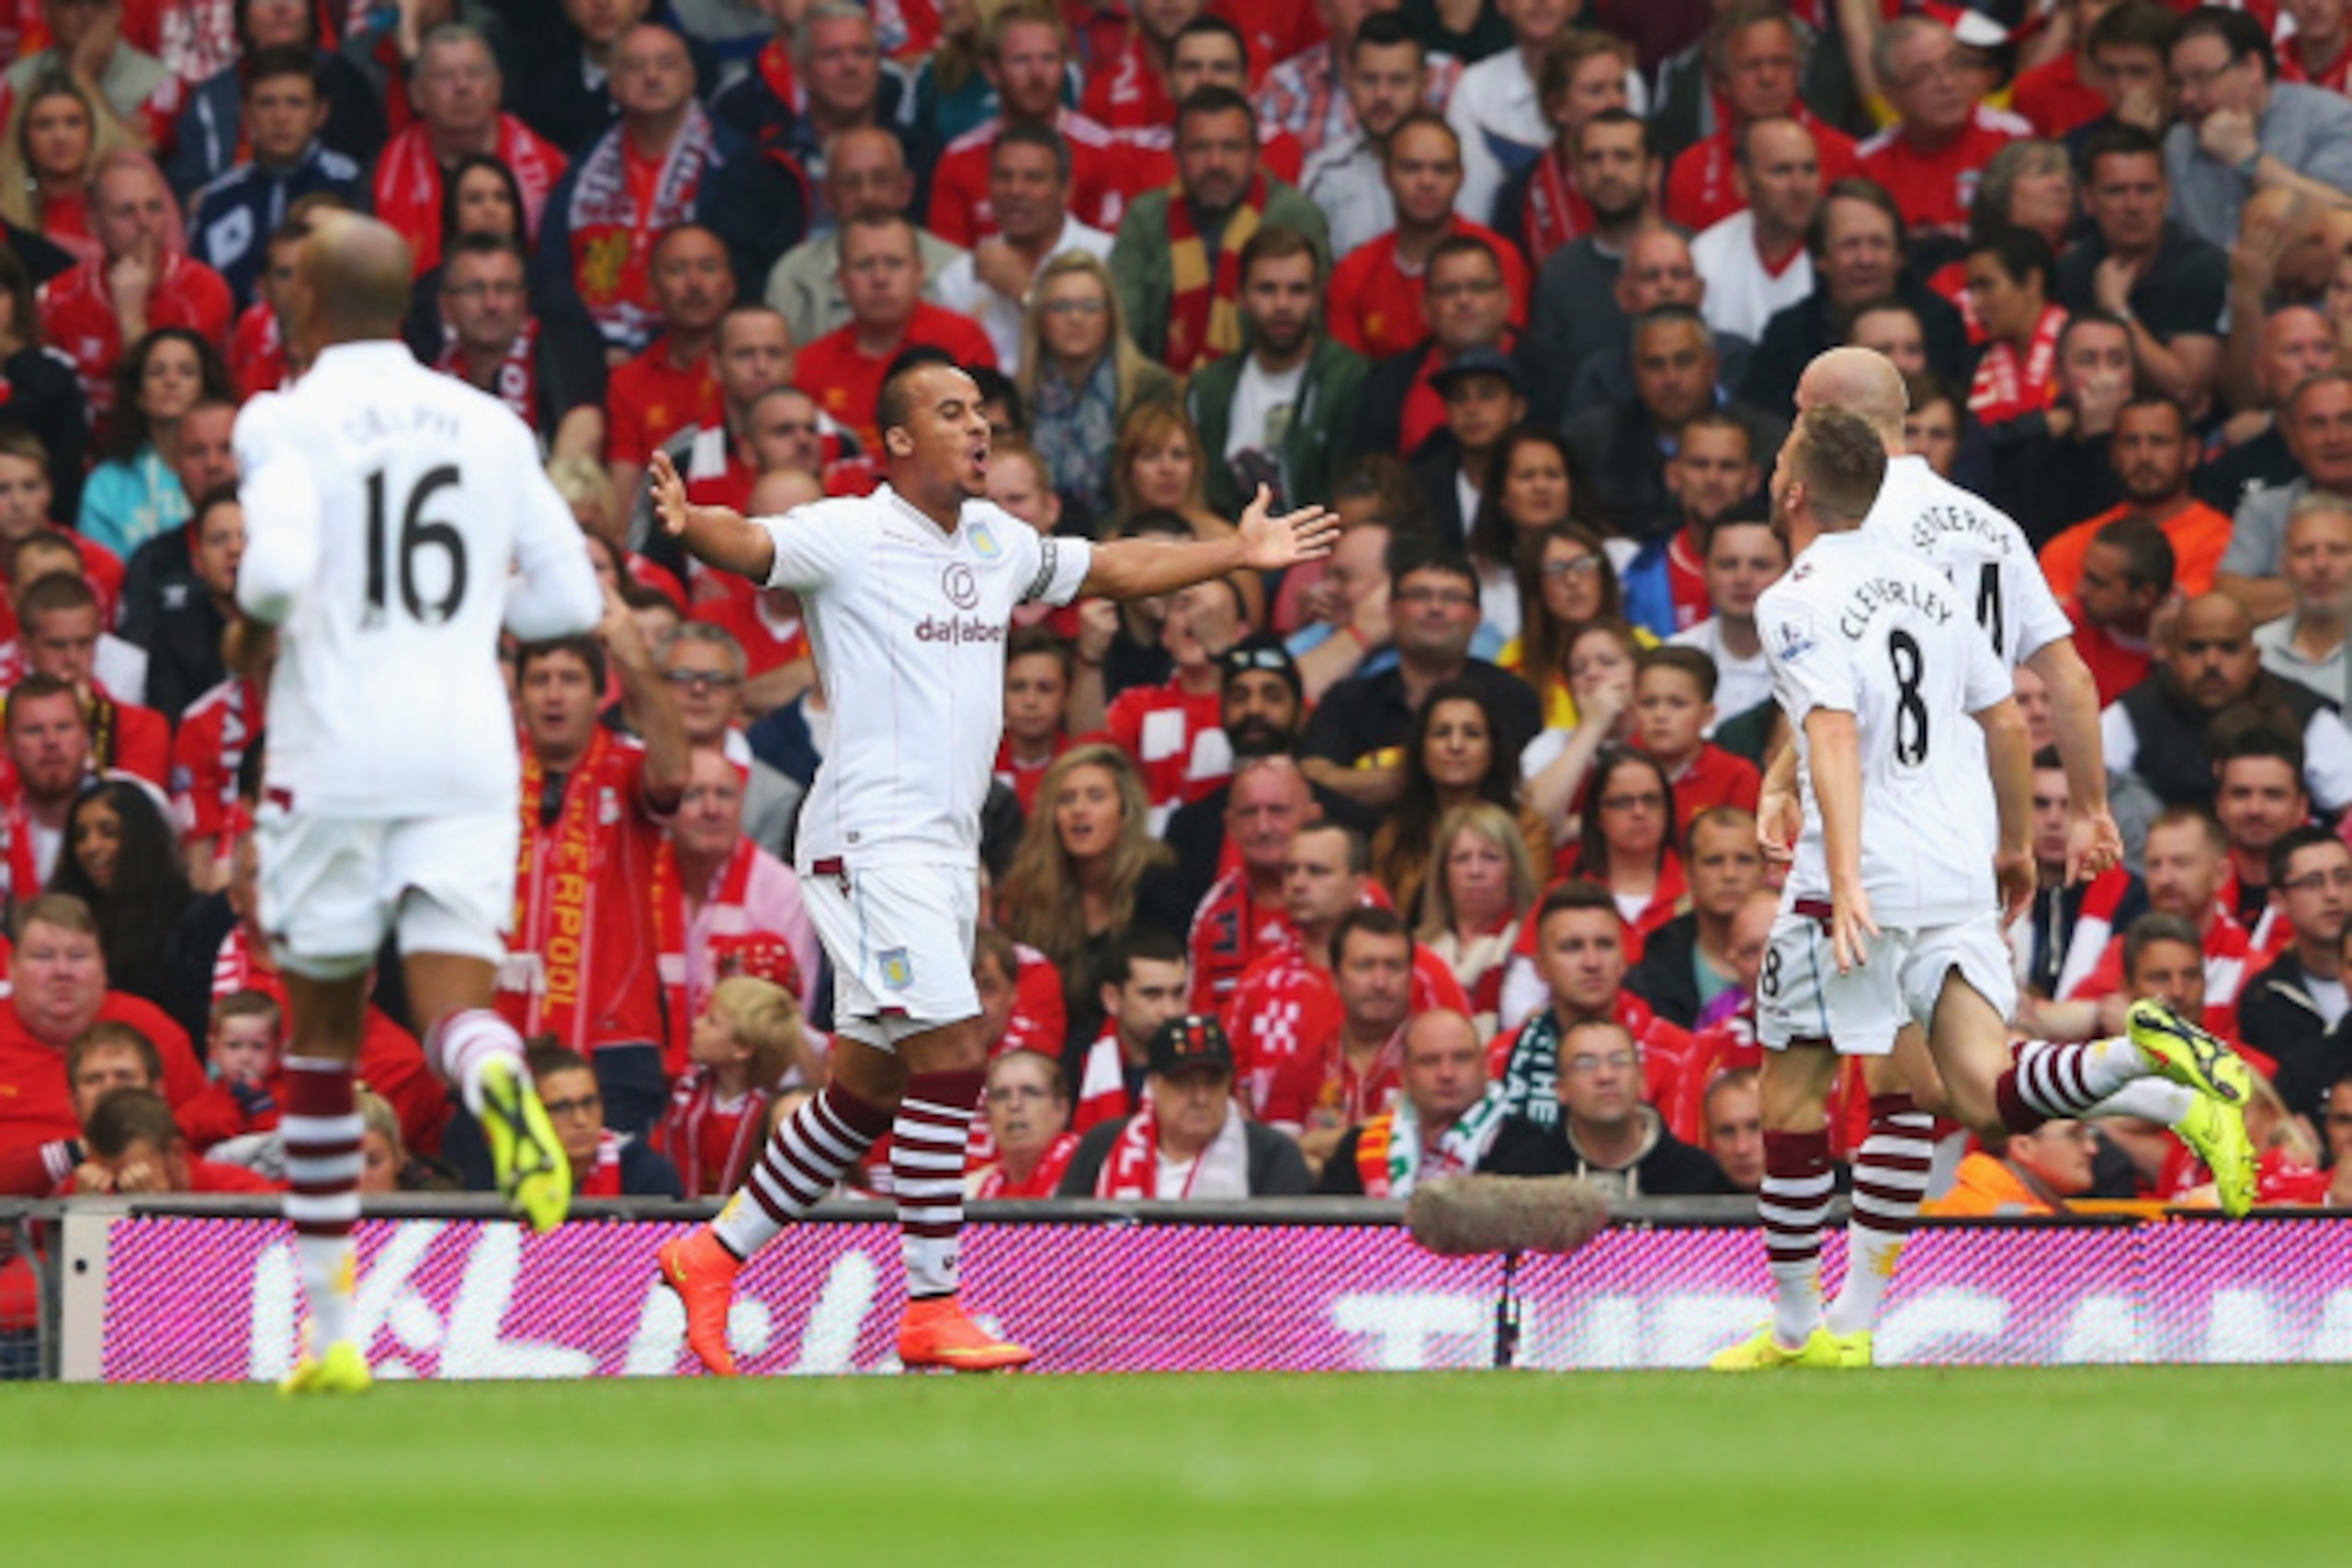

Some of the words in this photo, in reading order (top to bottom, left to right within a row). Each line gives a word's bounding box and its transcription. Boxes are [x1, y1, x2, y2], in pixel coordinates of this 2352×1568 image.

[362, 463, 469, 625] 16
[1840, 578, 1953, 640] CLEVERLEY
[1888, 627, 1929, 767] 8
[541, 770, 594, 1018] IVERPOOL
[1763, 946, 1781, 998] 8
